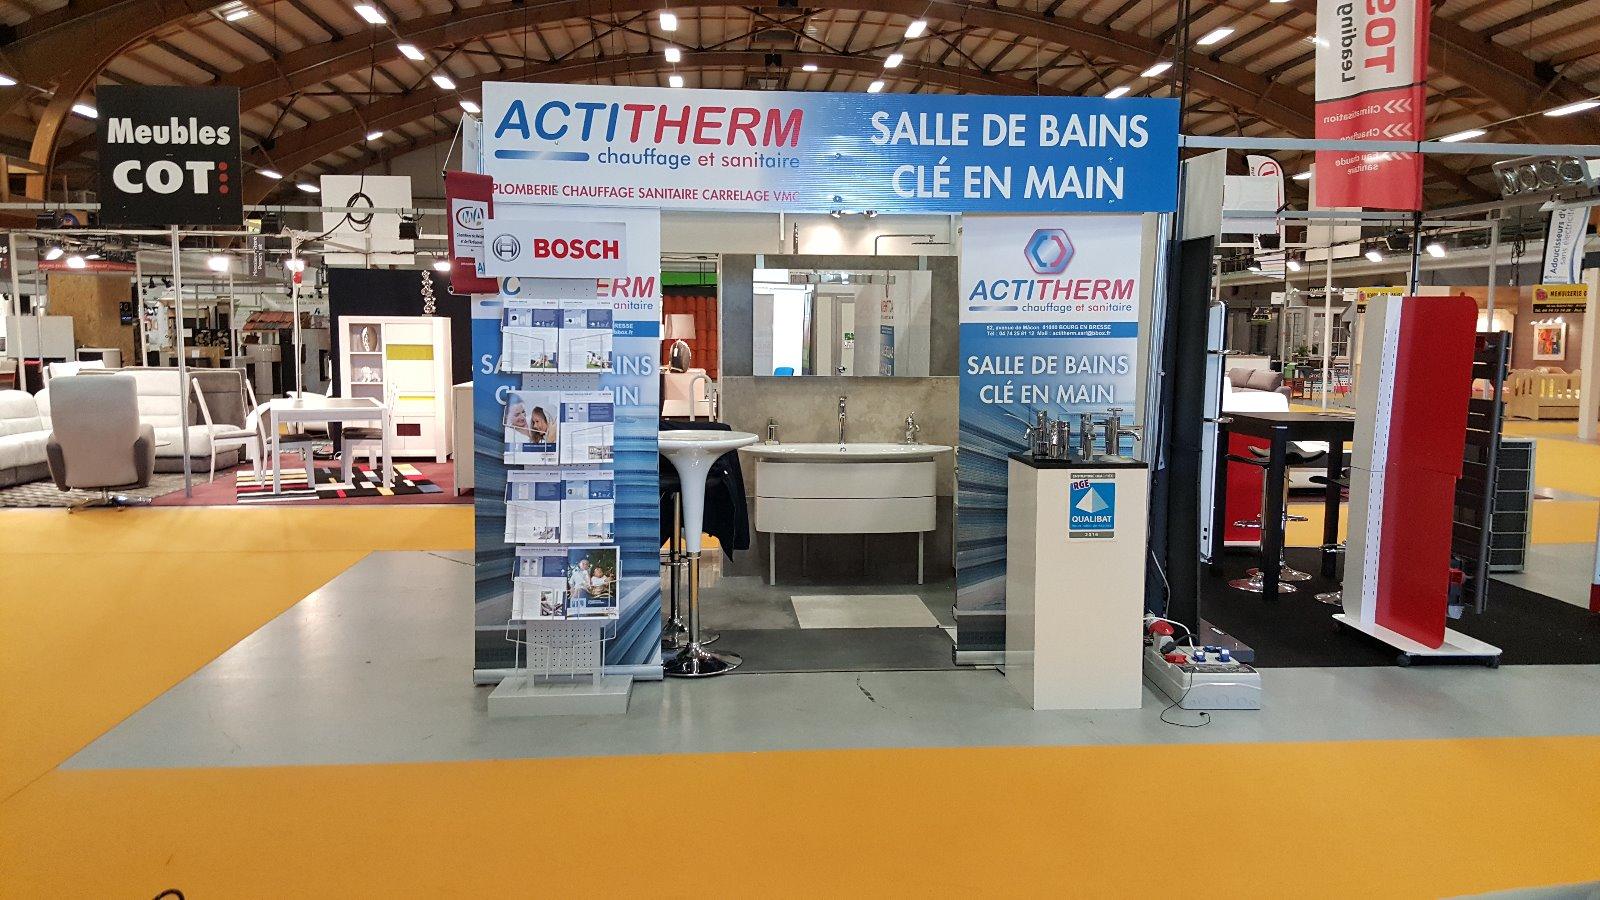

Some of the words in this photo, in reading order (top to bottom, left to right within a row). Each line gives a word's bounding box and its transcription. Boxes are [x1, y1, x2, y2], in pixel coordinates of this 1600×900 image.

[107, 116, 231, 147] Meubles
[494, 99, 804, 148] ACTITHERM
[870, 110, 970, 147] SALLE
[982, 113, 1026, 147] DE
[1038, 113, 1149, 148] BAINS
[597, 147, 692, 170] chauffage
[697, 151, 716, 167] et
[722, 151, 800, 169] sanitaire
[112, 160, 215, 195] COT
[891, 155, 950, 198] CLÉ
[963, 165, 1012, 199] EN
[1024, 165, 1124, 200] MAIN
[492, 183, 559, 196] PLOMBERIE
[562, 184, 635, 199] CHAUFFAGE
[638, 187, 699, 200] SANITAIRE
[702, 188, 770, 202] CARRELAGE
[773, 191, 801, 202] VMC
[533, 238, 620, 260] BOSCH
[1549, 221, 1565, 275] Adoucisseurs
[968, 279, 1135, 301] ACTITHERM
[613, 300, 654, 310] anitaire
[1021, 302, 1073, 314] chauffage
[1075, 303, 1085, 312] et
[1087, 303, 1132, 312] sanitaire
[967, 355, 1025, 375] SALLE
[1031, 355, 1058, 375] DE
[1065, 355, 1129, 375] BAINS
[979, 380, 1013, 404] CLÉ
[1021, 384, 1049, 404] EN
[1056, 384, 1114, 404] MAIN
[1072, 479, 1090, 490] RGE
[1071, 515, 1113, 523] QUALIBAT
